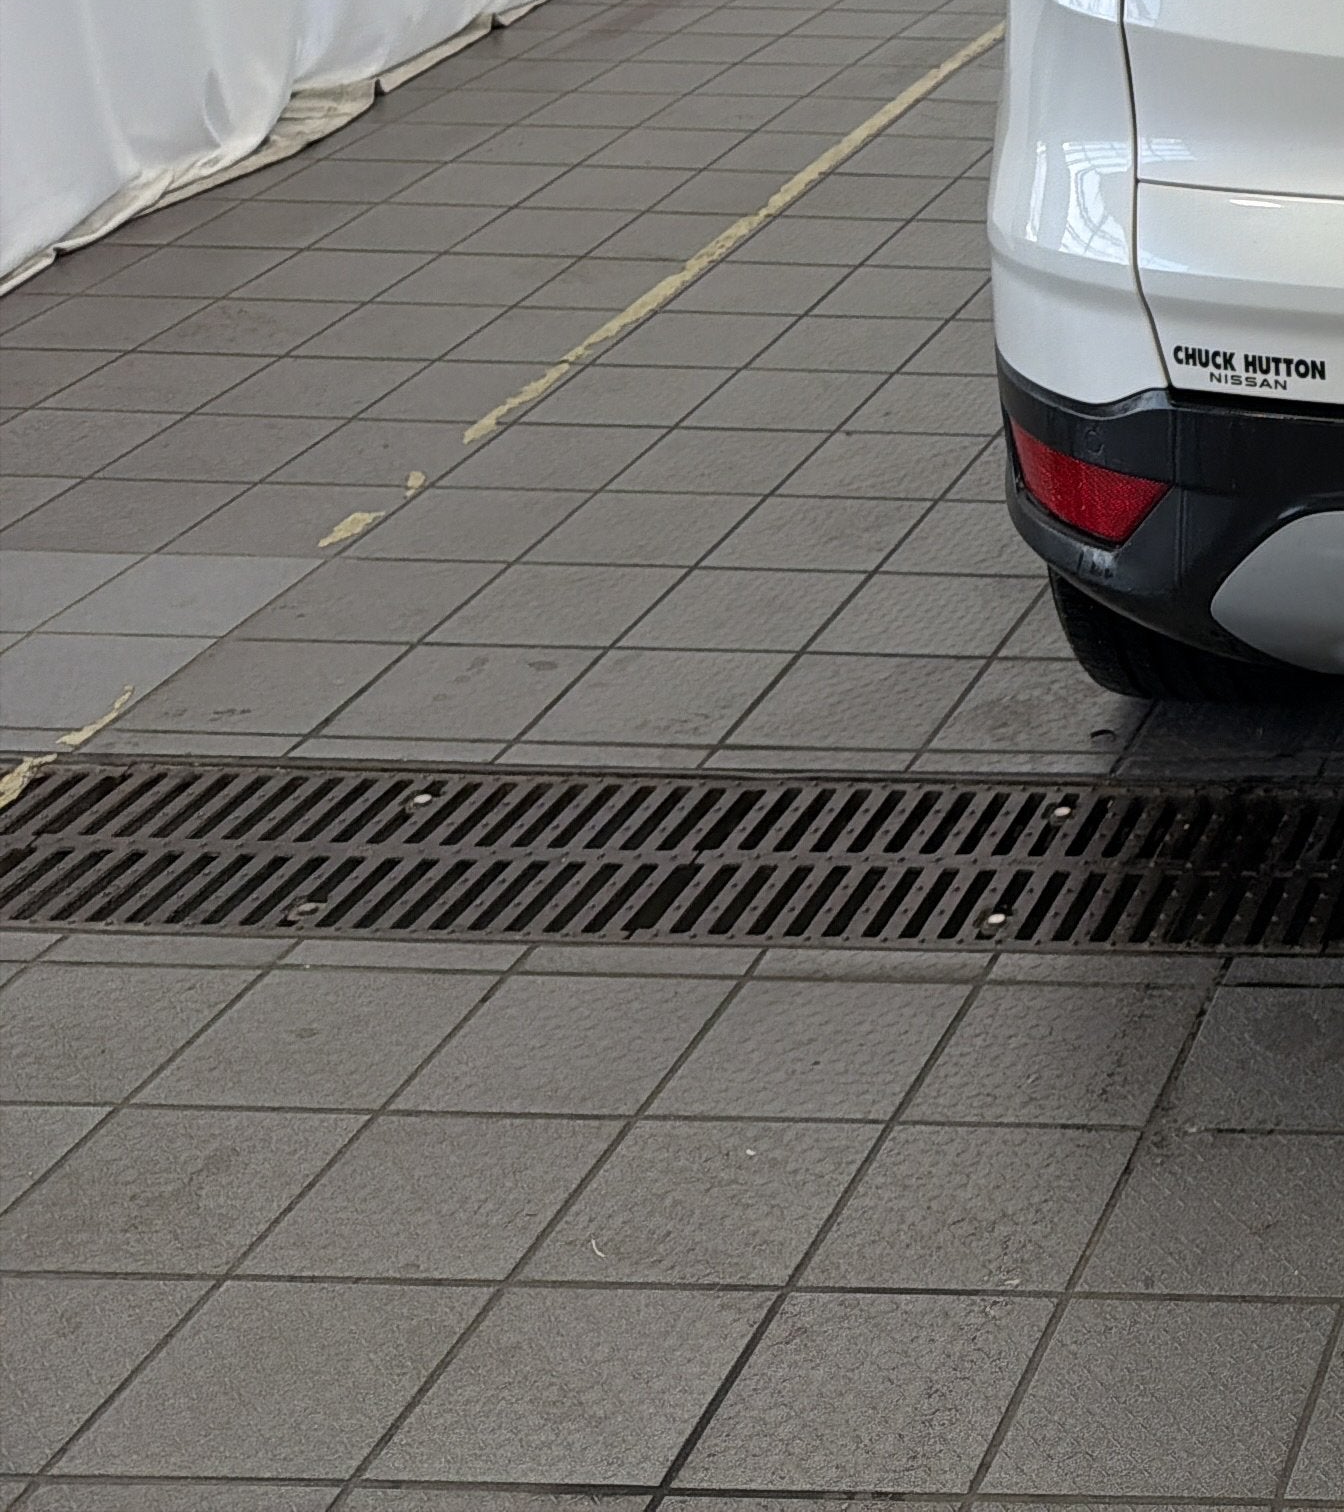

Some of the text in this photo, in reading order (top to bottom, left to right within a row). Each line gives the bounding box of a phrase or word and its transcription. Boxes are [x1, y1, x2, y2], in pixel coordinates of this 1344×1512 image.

[1173, 345, 1326, 380] CHUCK HUTTON
[1209, 371, 1288, 391] NISSAN
